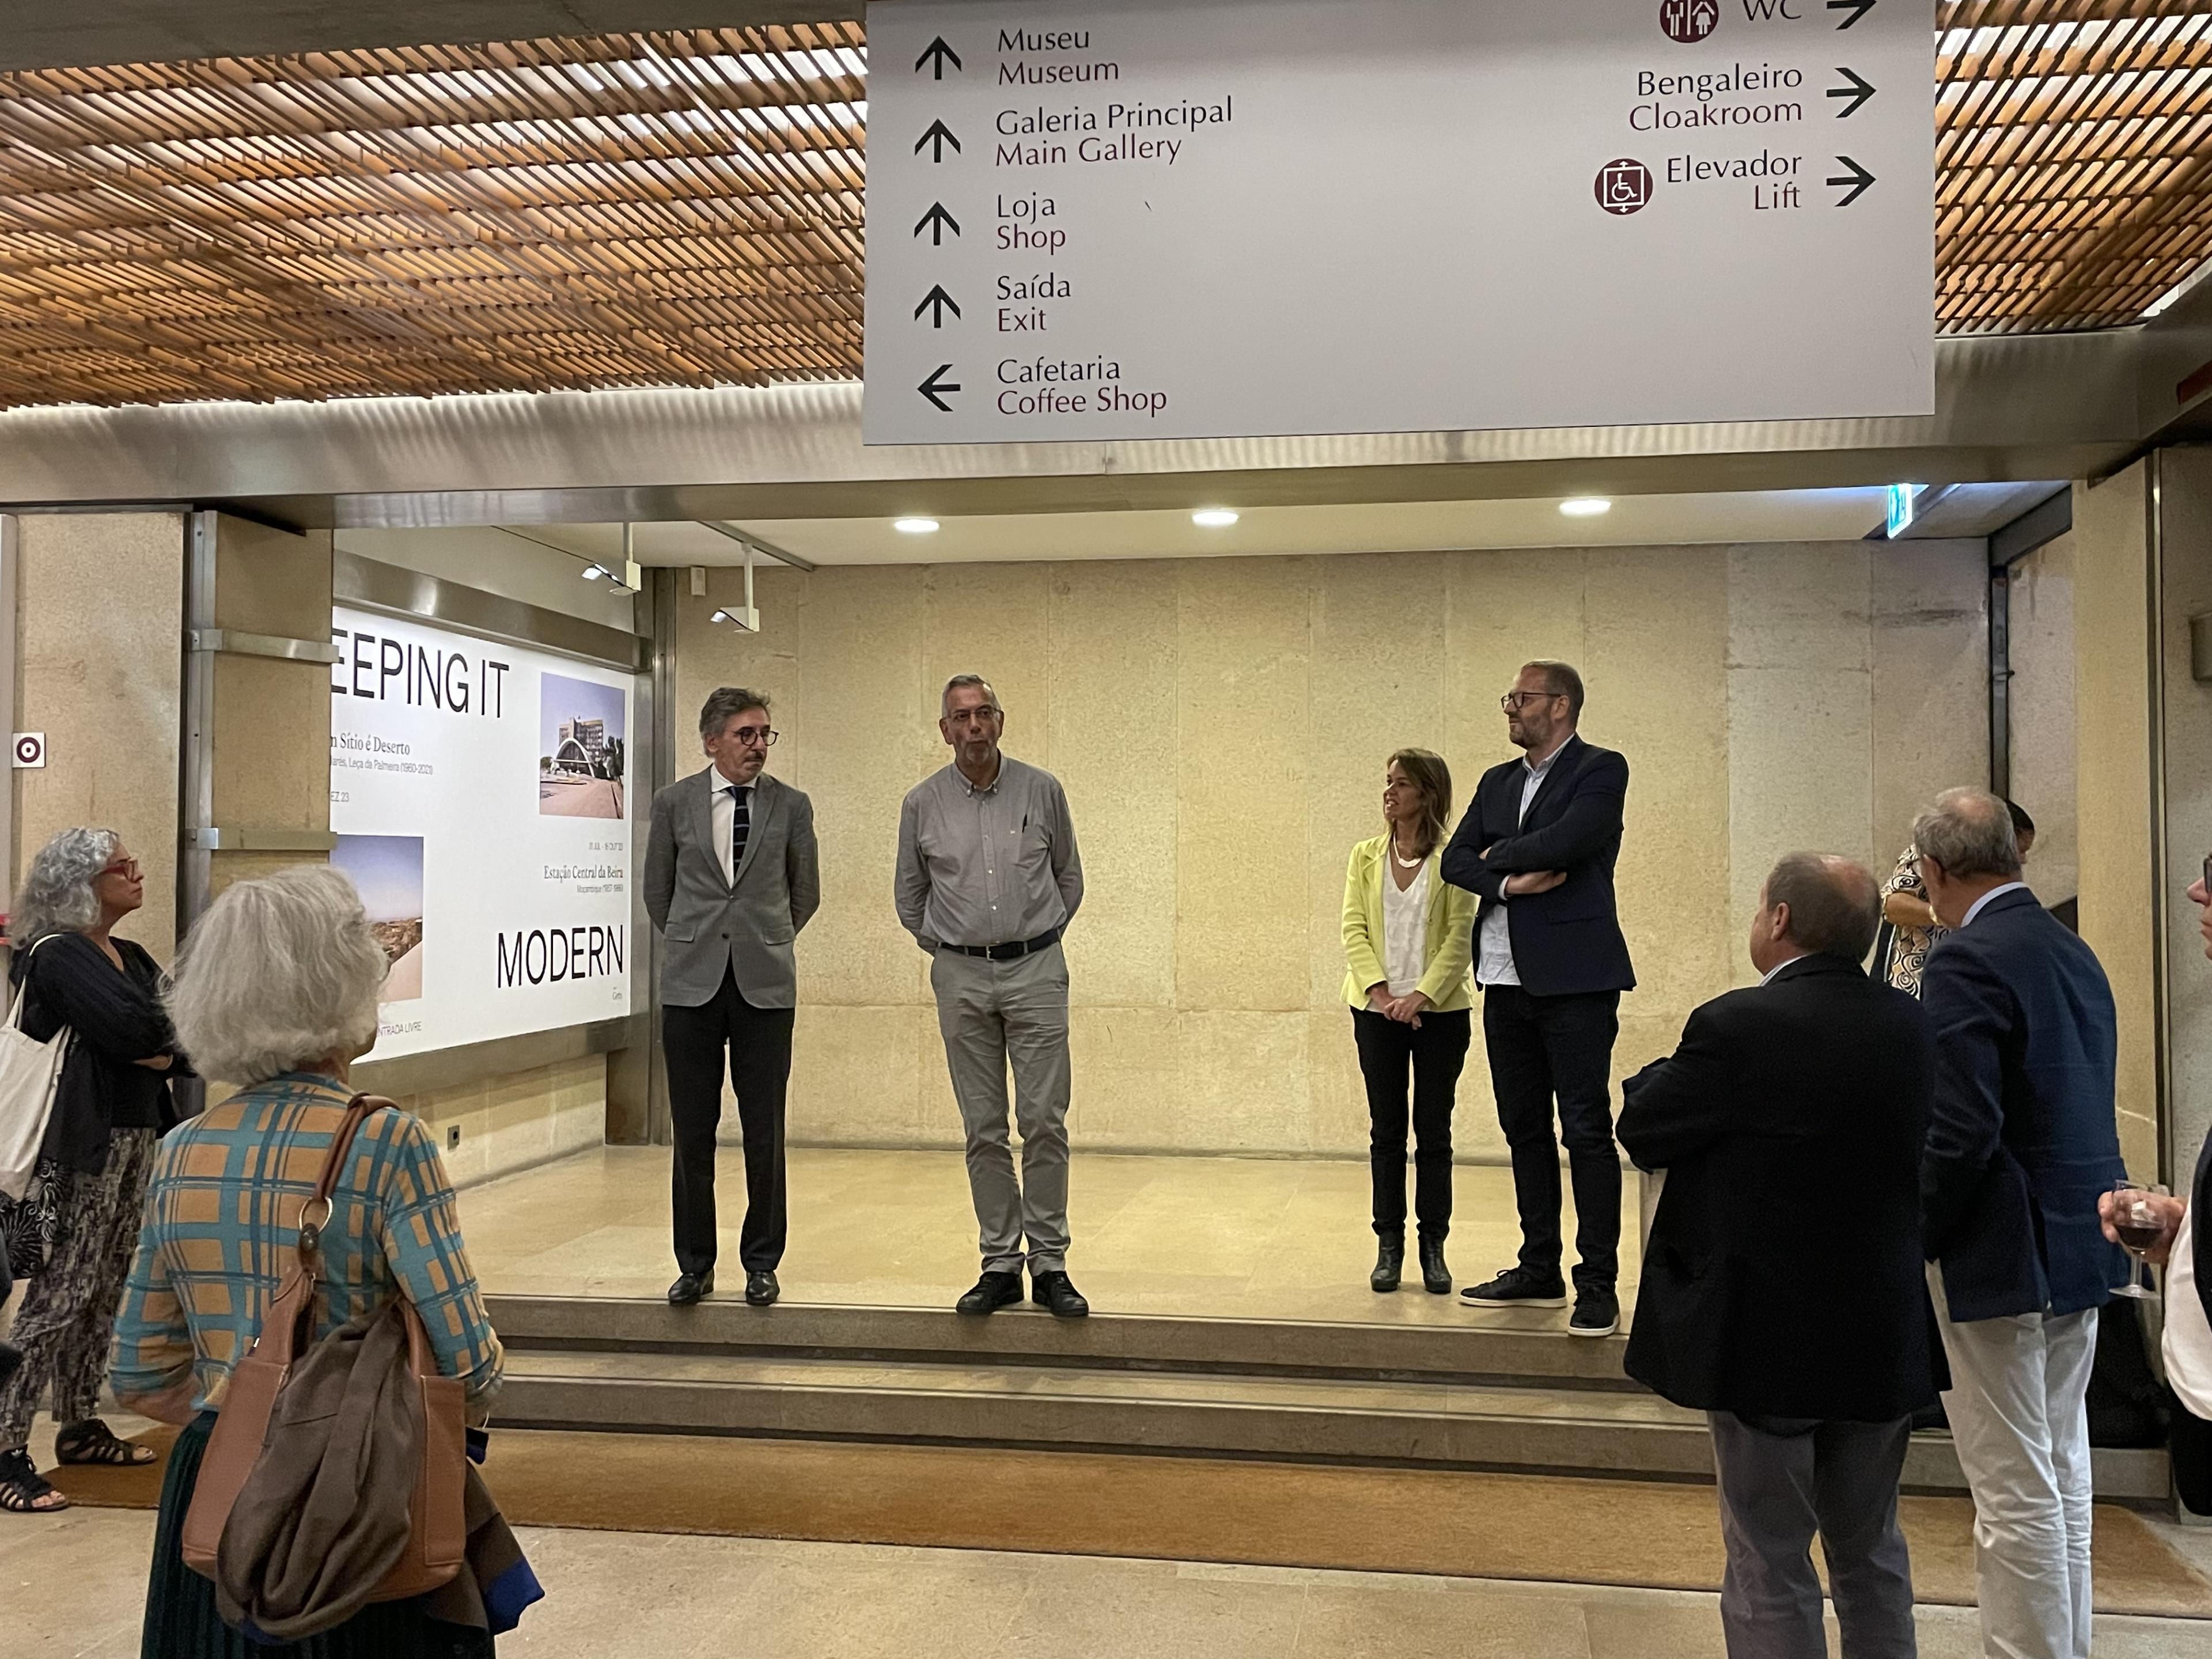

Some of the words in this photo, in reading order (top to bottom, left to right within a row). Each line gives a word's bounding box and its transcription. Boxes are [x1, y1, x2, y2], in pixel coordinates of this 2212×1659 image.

[1743, 0, 1802, 21] WC
[998, 28, 1089, 52] Museu
[999, 61, 1119, 85] Museum
[1638, 63, 1803, 102] Bengaleiro
[996, 106, 1097, 135] Galeria
[1108, 96, 1232, 132] Principal
[1629, 102, 1802, 131] Cloakroom
[996, 140, 1066, 166] Main
[1078, 133, 1182, 165] Gallery
[1667, 149, 1802, 183] Elevador
[997, 192, 1056, 224] Loja
[1754, 181, 1801, 210] Lift
[997, 224, 1066, 255] Shop
[997, 272, 1071, 300] Saída
[998, 306, 1047, 332] Exit
[997, 355, 1121, 384] Cafetaria
[997, 387, 1087, 415] Coffee
[1097, 386, 1167, 417] Shop
[482, 658, 509, 718] IT
[340, 732, 364, 751] Sítio
[365, 734, 372, 751] é
[373, 736, 411, 755] Deserto
[349, 757, 364, 770] Leça
[365, 759, 373, 769] da
[340, 791, 350, 802] 23
[544, 865, 571, 883] Estação
[572, 864, 597, 879] Central
[598, 865, 606, 878] da
[607, 865, 623, 878] Beira
[498, 924, 623, 988] MODERN
